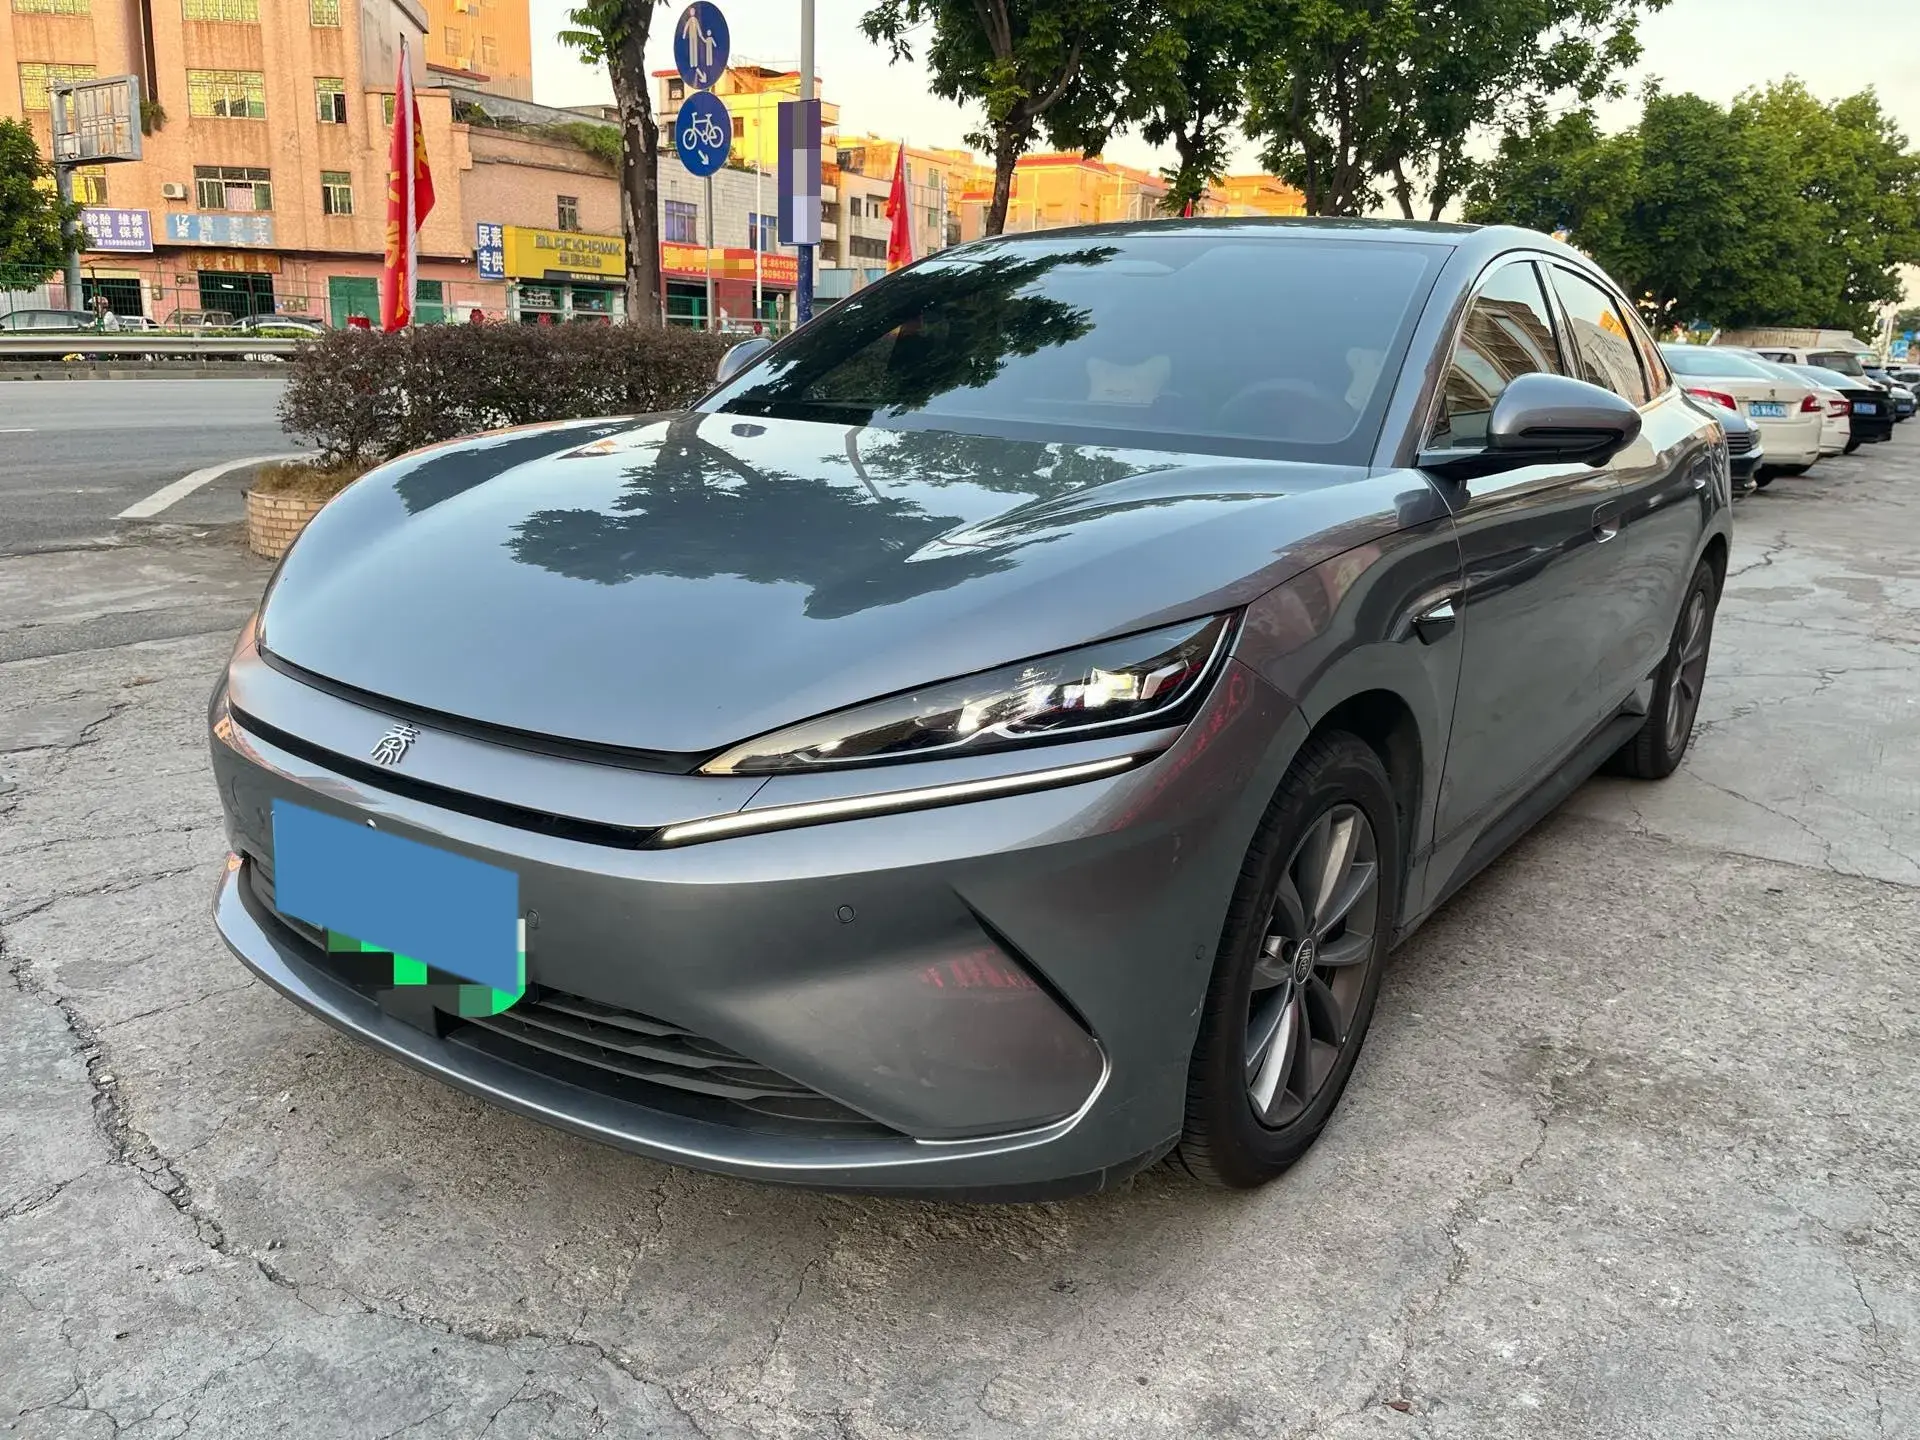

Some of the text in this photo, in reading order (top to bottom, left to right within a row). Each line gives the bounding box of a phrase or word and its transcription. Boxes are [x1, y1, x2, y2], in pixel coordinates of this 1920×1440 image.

[86, 213, 111, 226] 轮胎
[87, 226, 144, 239] 电池 保养
[478, 225, 502, 248] 尿素
[534, 234, 622, 256] BLACKHAWK
[479, 250, 504, 273] 专供
